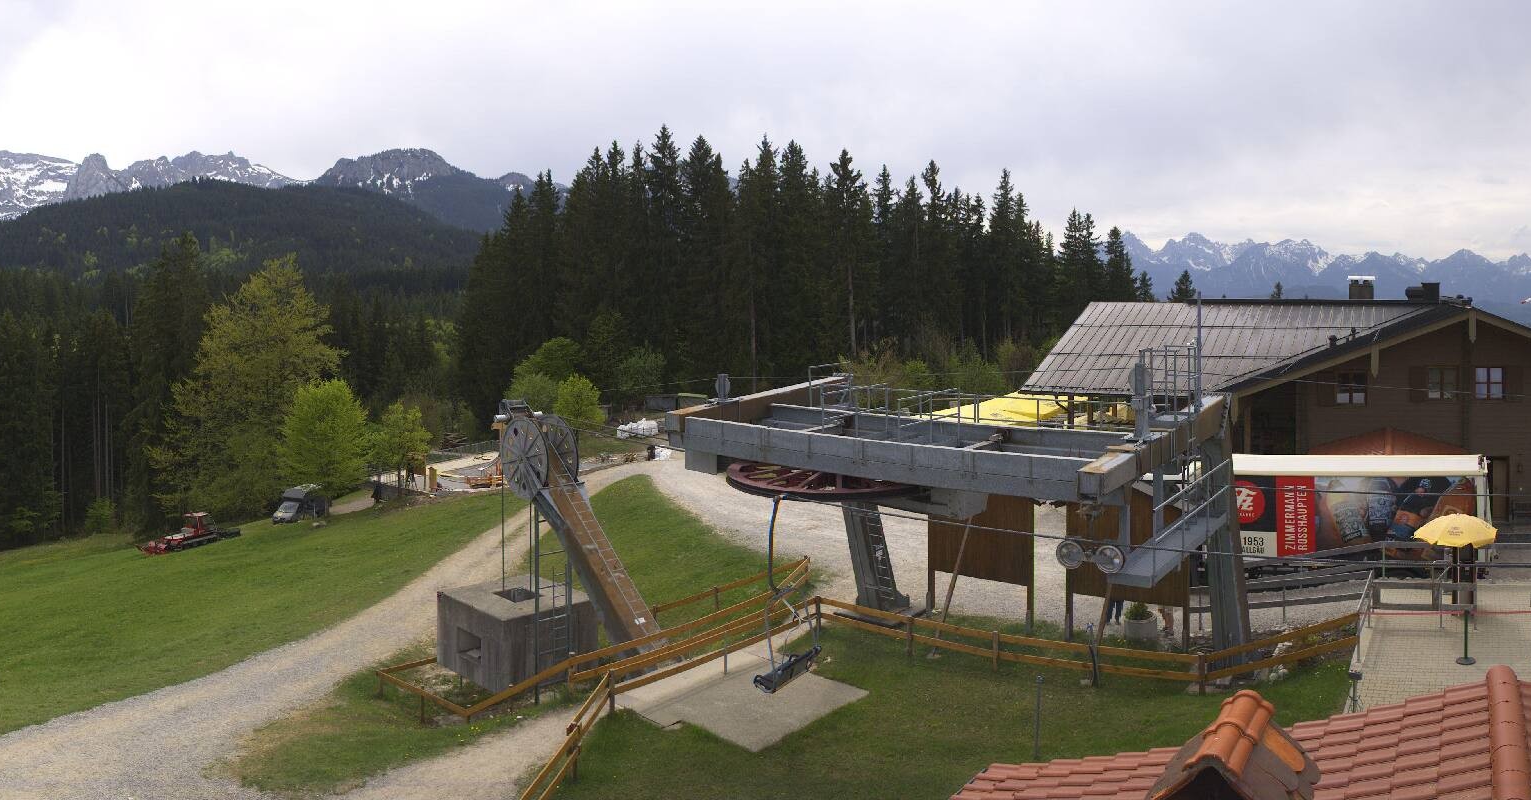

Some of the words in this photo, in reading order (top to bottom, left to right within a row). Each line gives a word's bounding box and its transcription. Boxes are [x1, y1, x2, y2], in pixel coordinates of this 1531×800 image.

[1243, 536, 1264, 546] 1953
[1284, 485, 1296, 550] ZIMMERMANN
[1296, 485, 1308, 551] ROSSHAUPTEN
